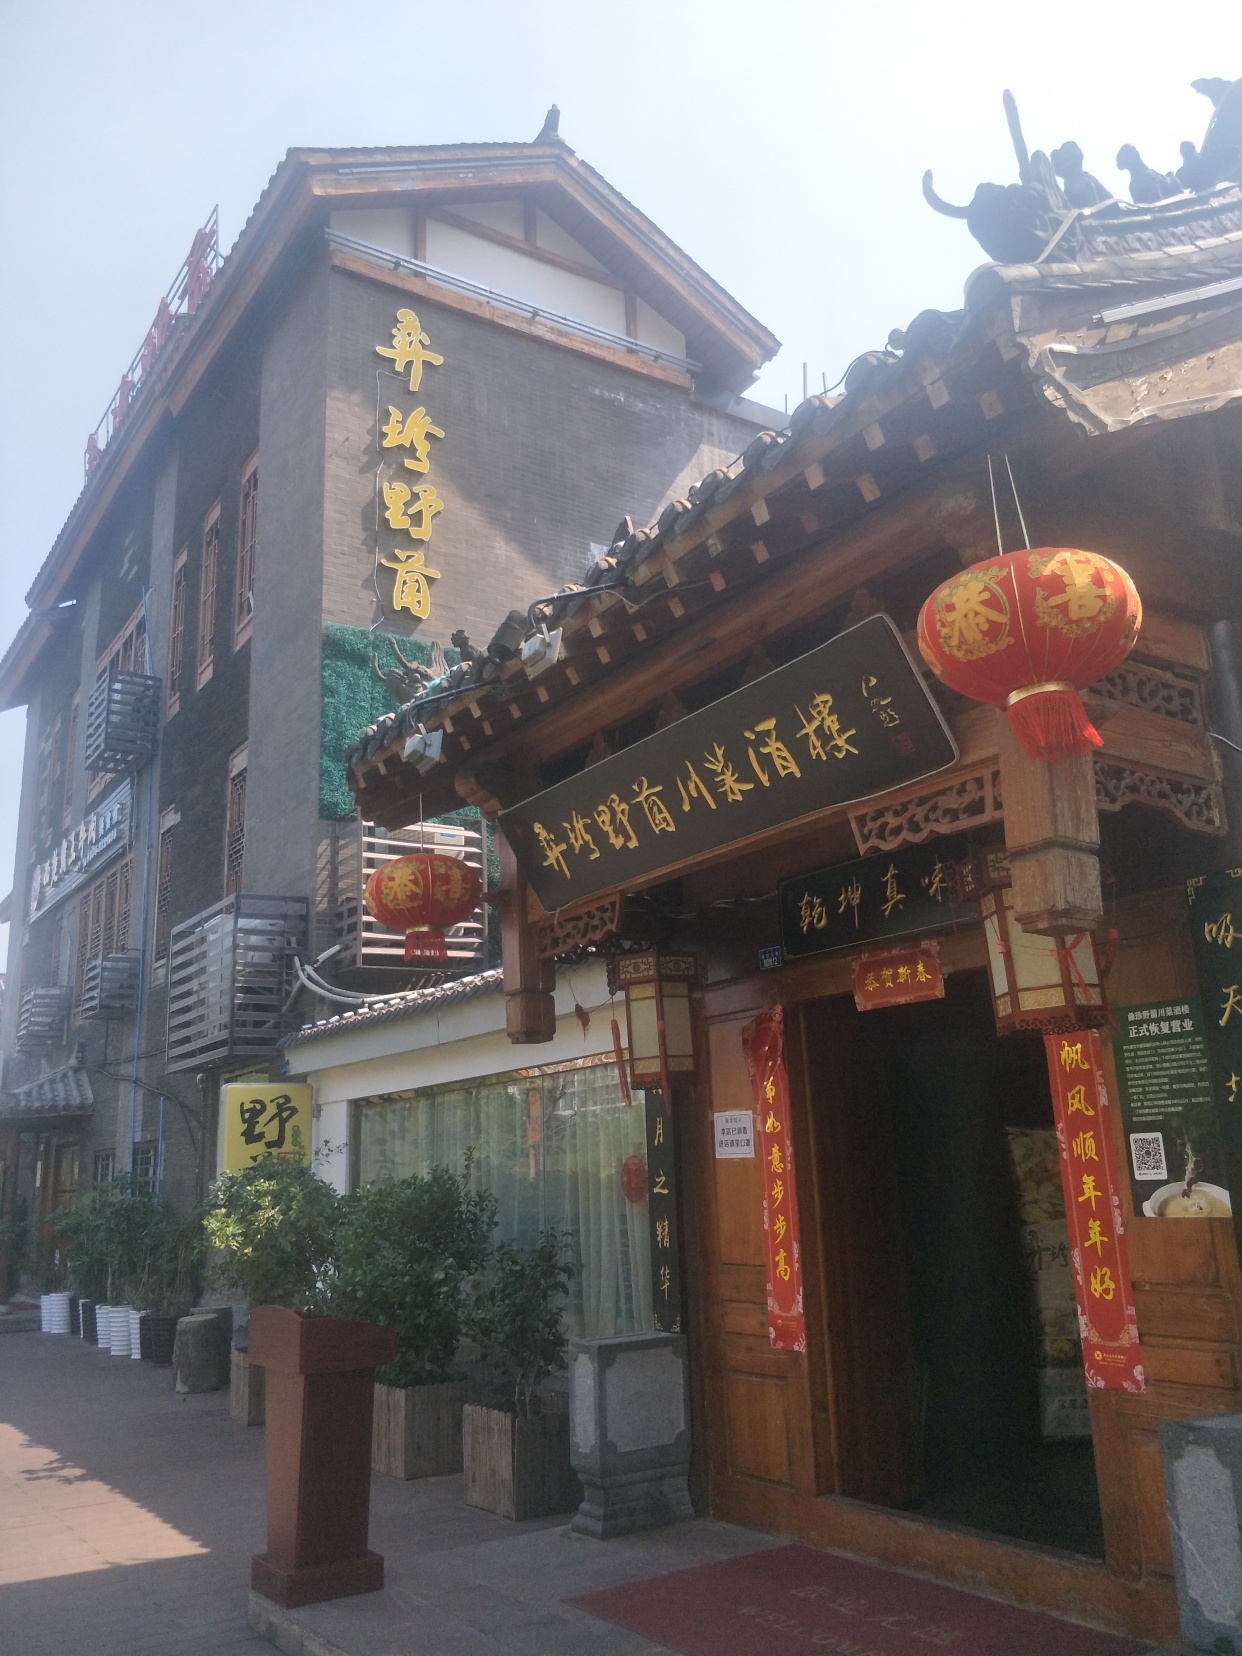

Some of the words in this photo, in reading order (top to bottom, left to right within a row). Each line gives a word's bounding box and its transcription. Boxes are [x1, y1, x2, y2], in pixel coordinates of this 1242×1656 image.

[864, 960, 932, 991] 恭贺新春
[1128, 1017, 1195, 1038] 正式恢复营业
[720, 1126, 748, 1137] 本店已消毒
[763, 1046, 791, 1282] 事如意步步高
[652, 1088, 672, 1301] 月之精华
